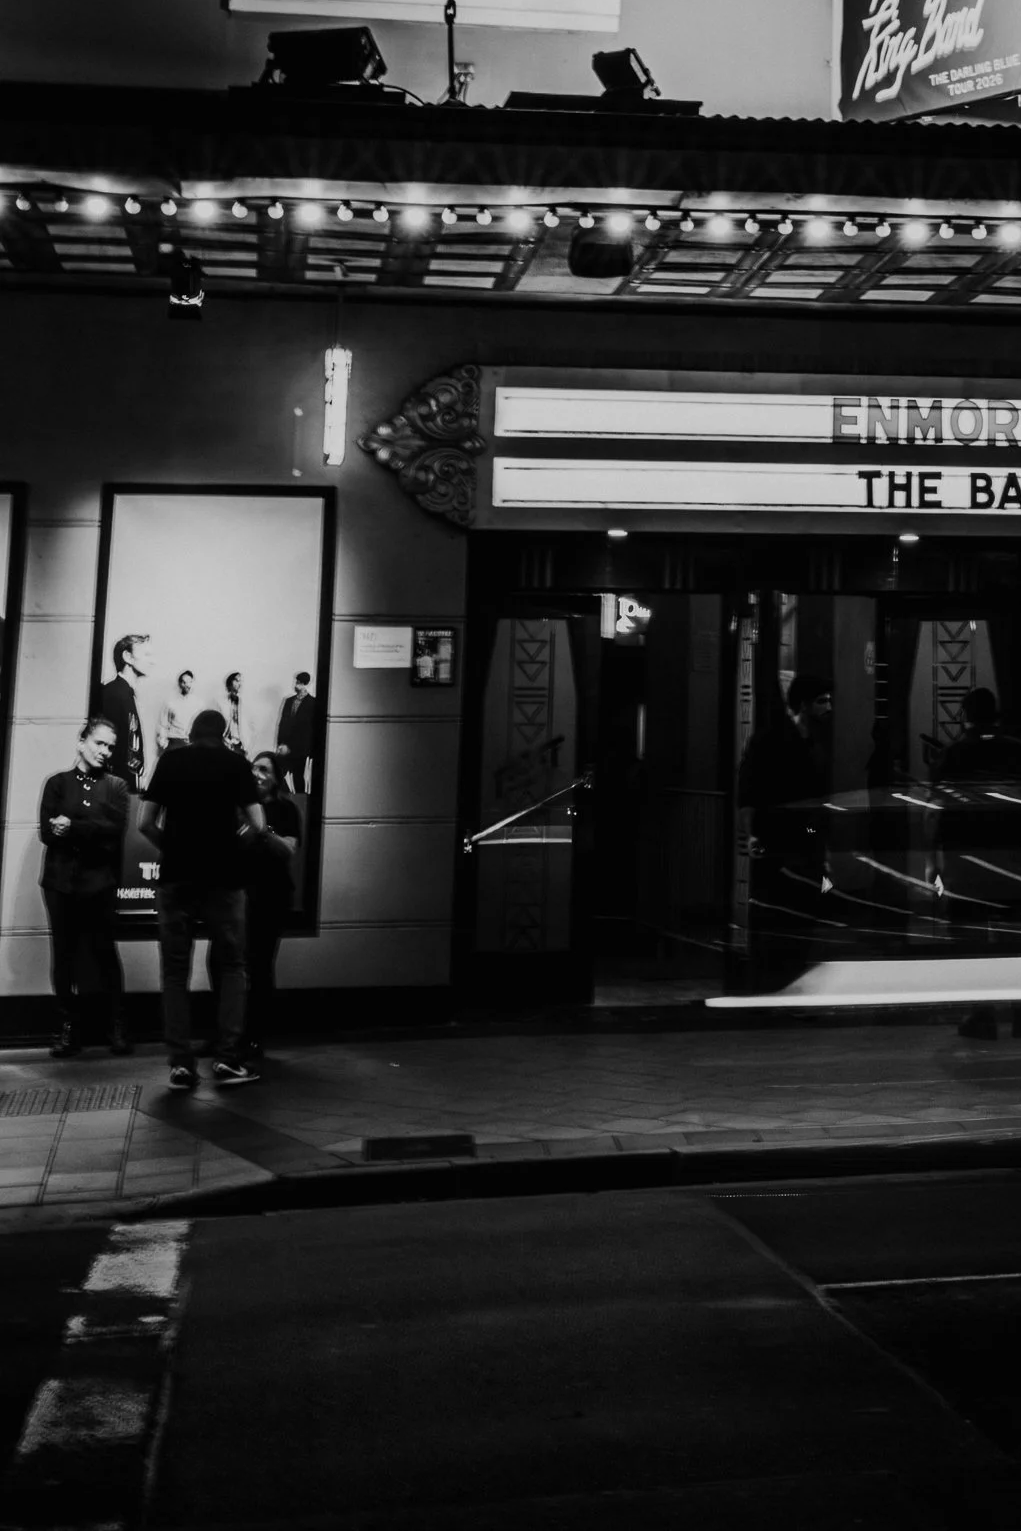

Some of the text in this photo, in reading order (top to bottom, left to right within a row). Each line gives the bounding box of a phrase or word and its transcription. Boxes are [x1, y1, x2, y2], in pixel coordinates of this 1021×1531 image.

[928, 71, 950, 86] THE
[947, 80, 975, 96] TOUR
[858, 470, 943, 508] THE
